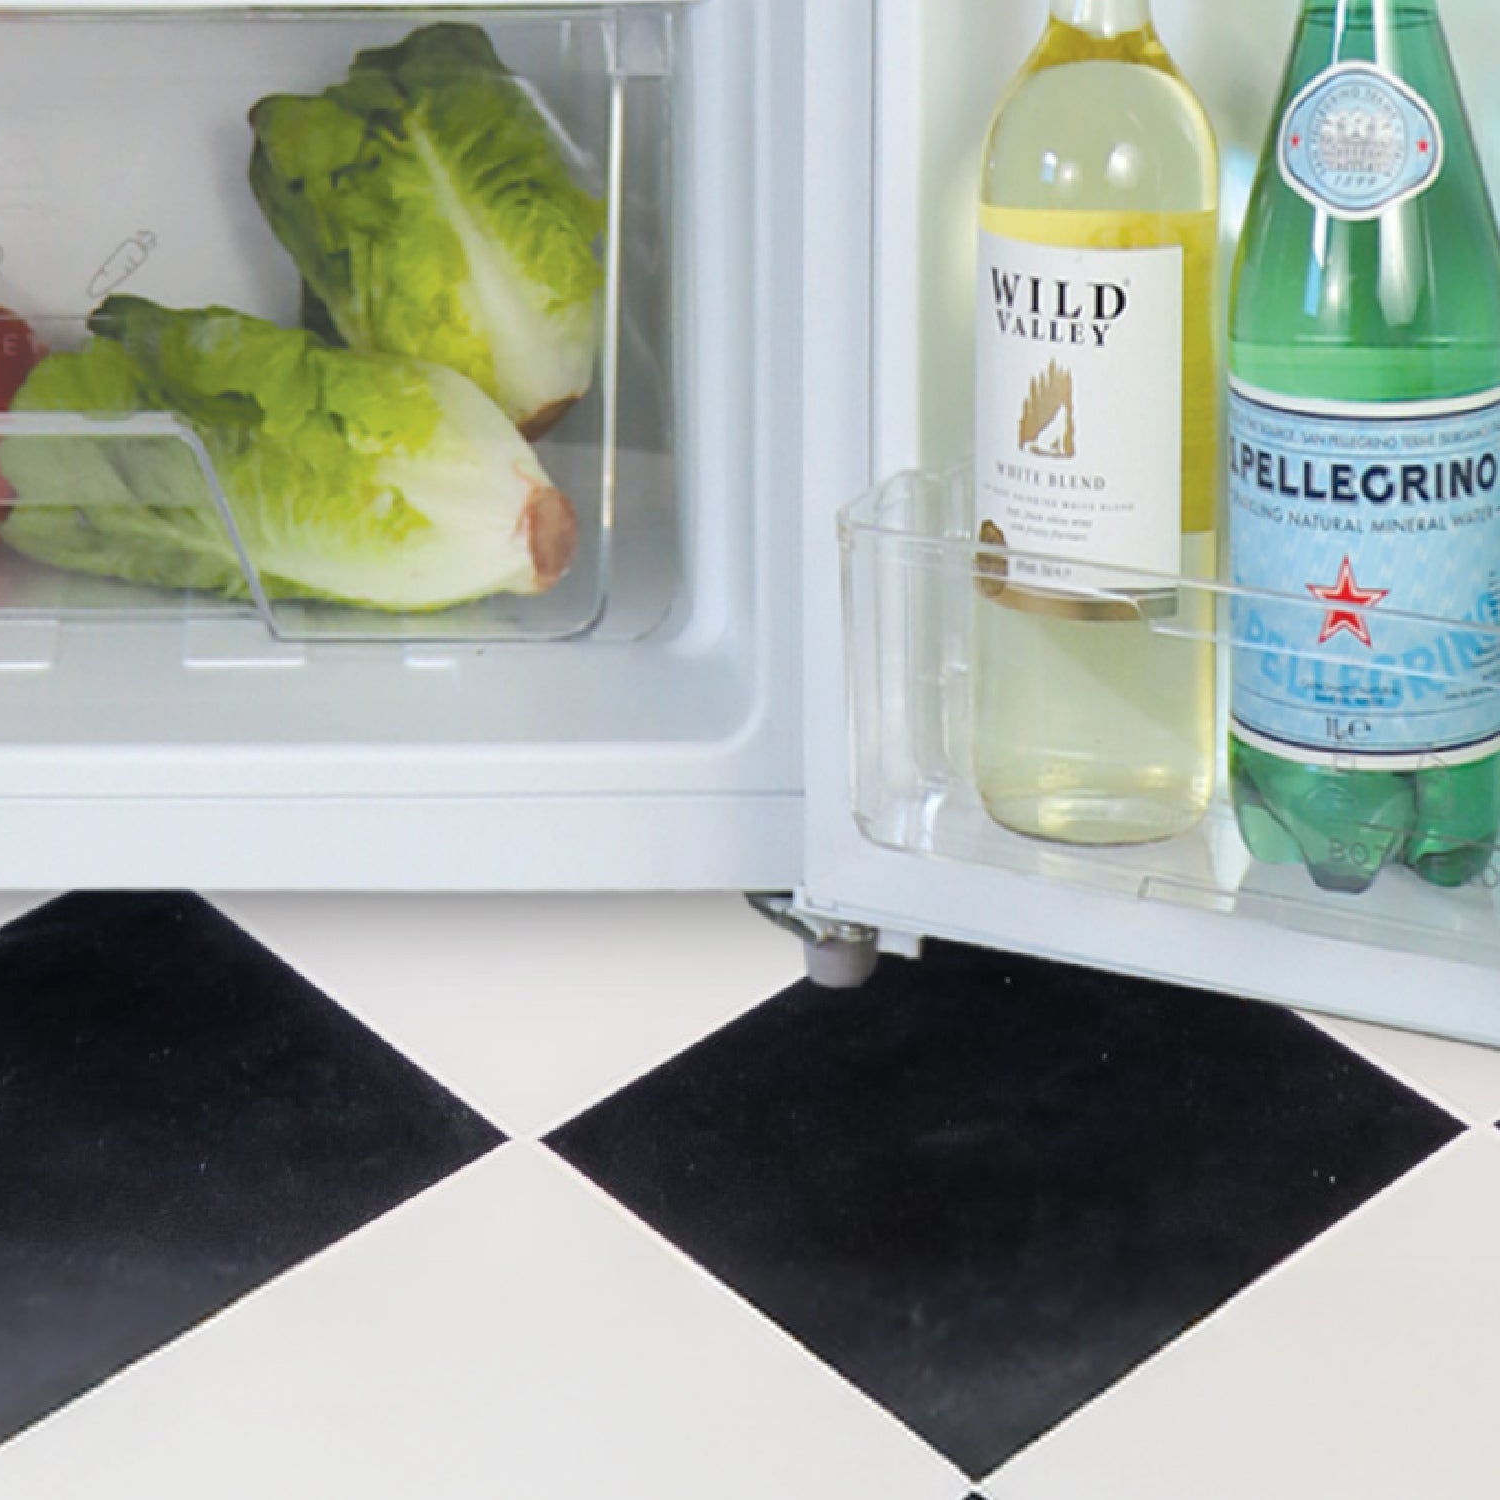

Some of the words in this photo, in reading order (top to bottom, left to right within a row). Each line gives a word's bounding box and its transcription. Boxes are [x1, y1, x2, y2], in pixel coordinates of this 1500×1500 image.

[991, 265, 1128, 320] WILD
[996, 309, 1110, 347] VALLEY
[1048, 472, 1107, 492] BLEND
[1287, 510, 1364, 534] NATURAL
[1370, 515, 1448, 534] MINERAL
